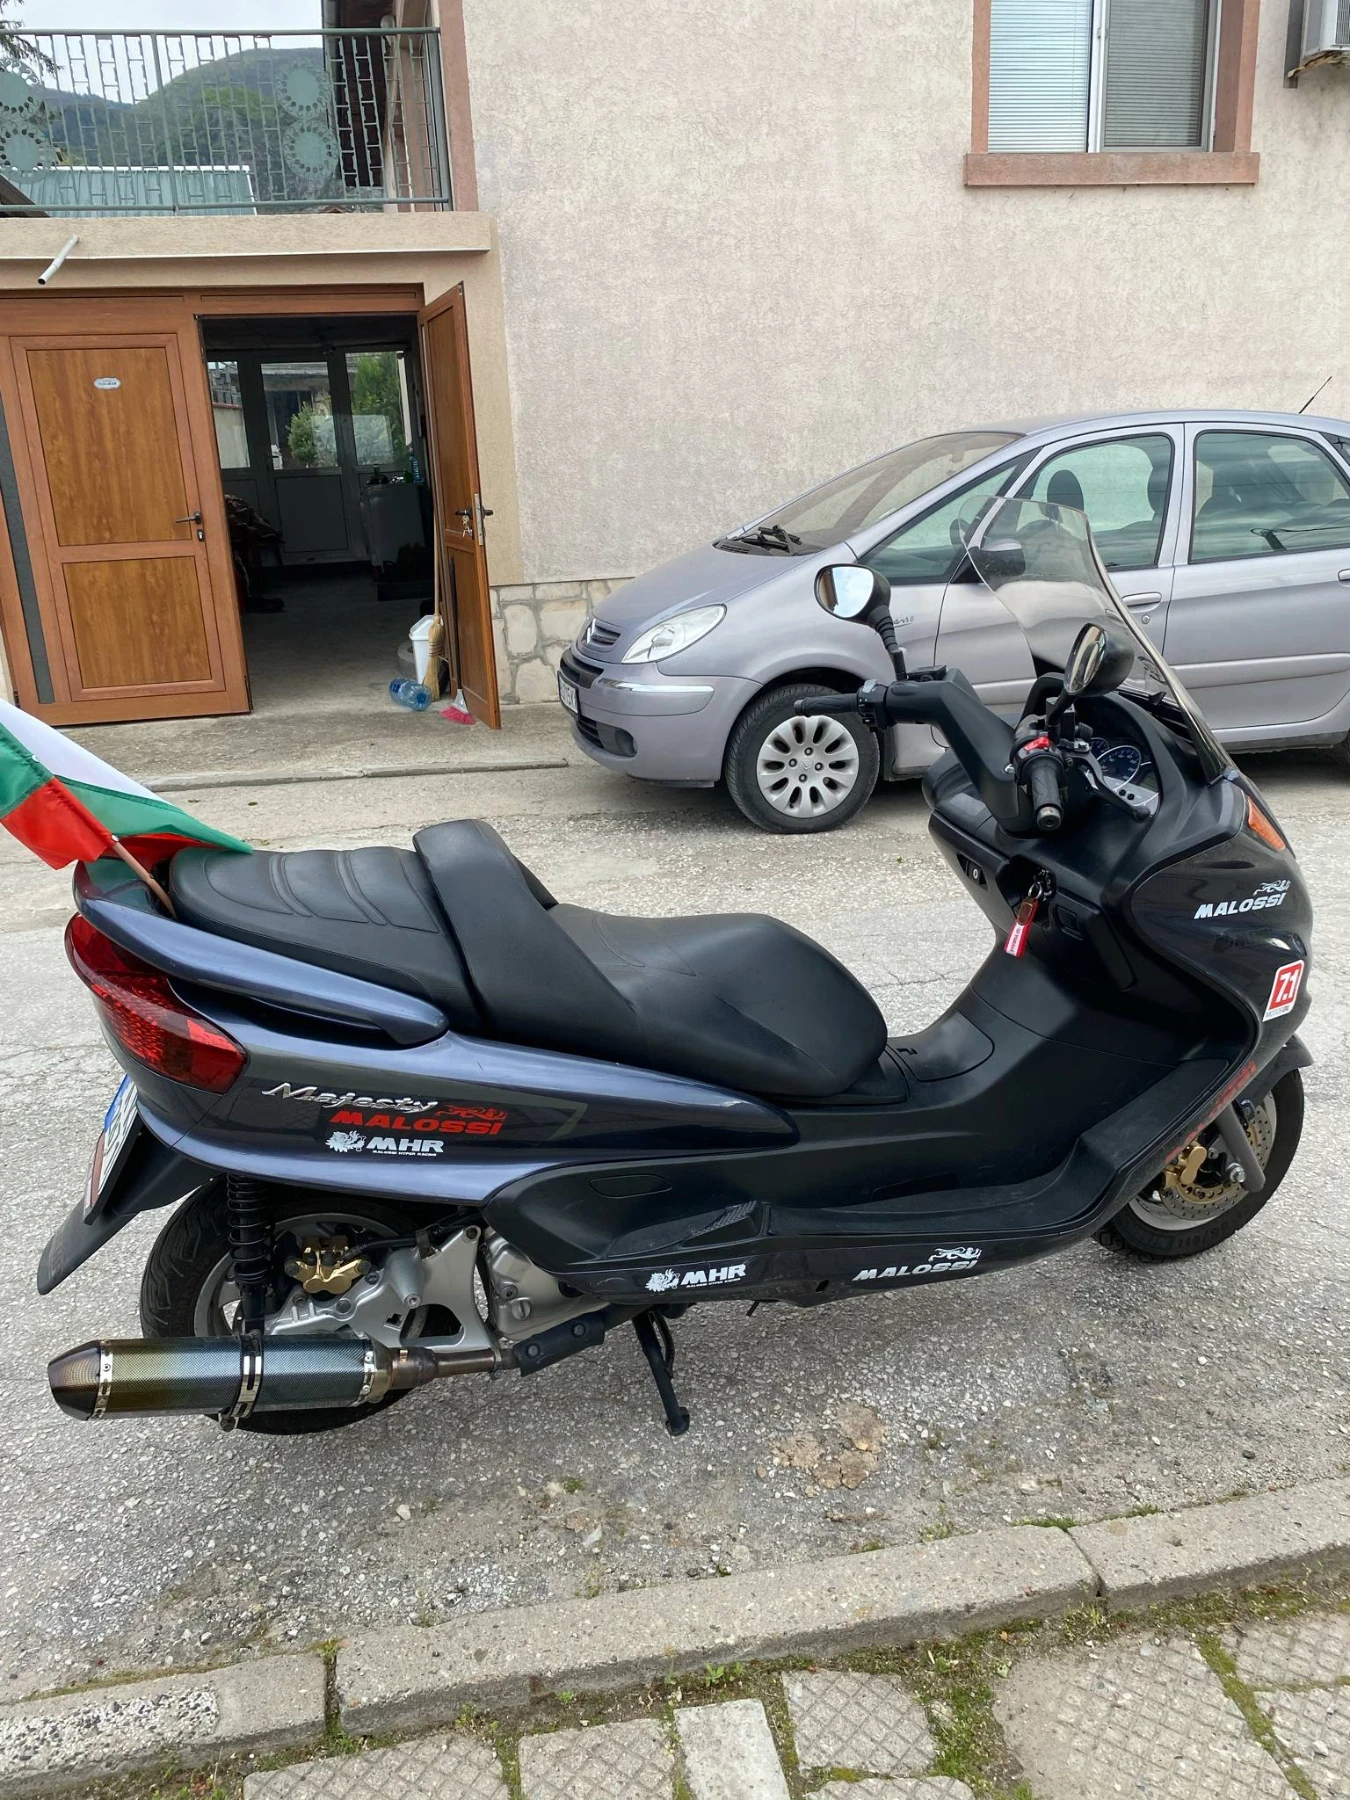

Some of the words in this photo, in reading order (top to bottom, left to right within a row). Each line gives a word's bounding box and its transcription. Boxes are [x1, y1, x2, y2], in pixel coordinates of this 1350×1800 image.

[1194, 893, 1287, 919] MALOSSI
[262, 1082, 438, 1114] Majesty
[330, 1110, 503, 1135] MALOSSI
[366, 1136, 444, 1153] MHR
[680, 1264, 746, 1286] MHR
[852, 1260, 978, 1281] MALOSSI
